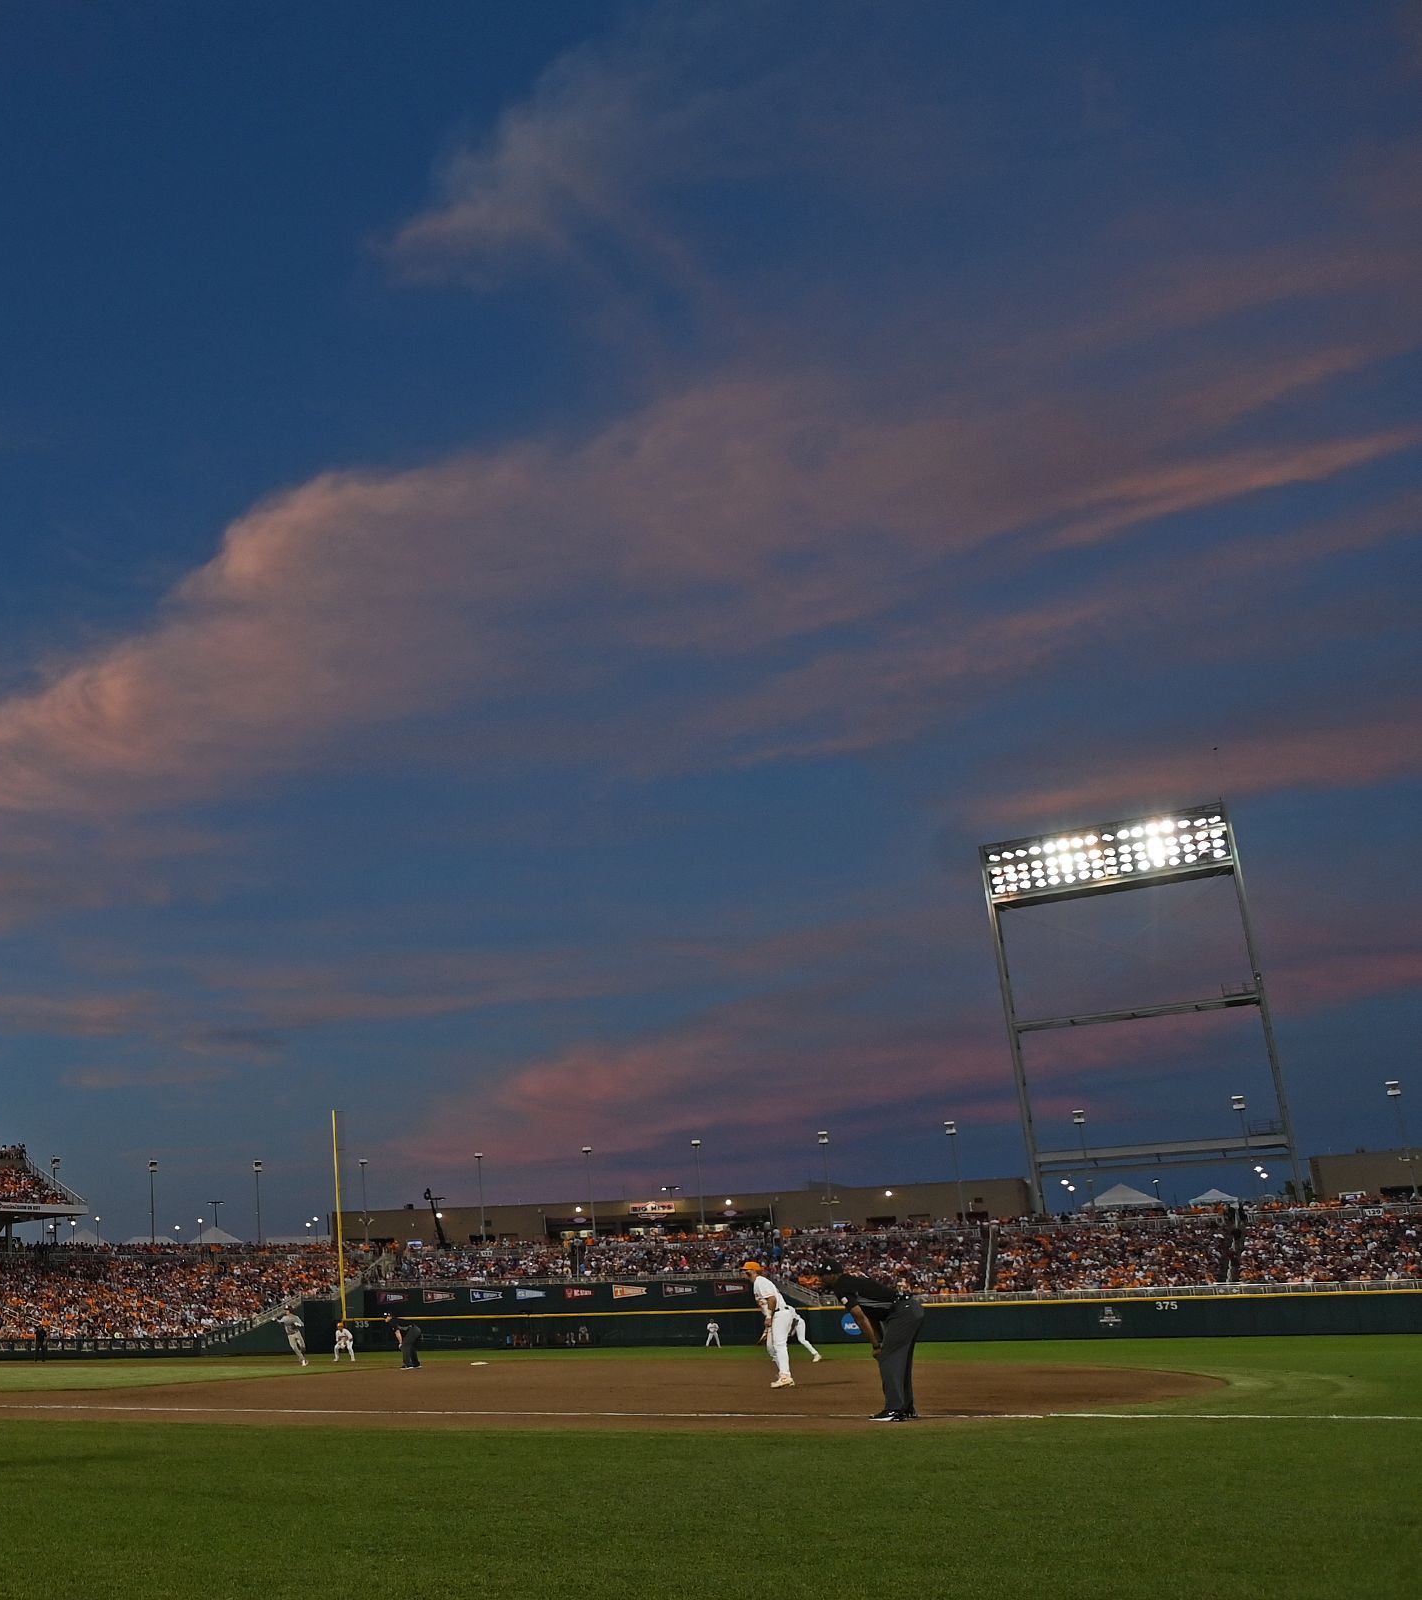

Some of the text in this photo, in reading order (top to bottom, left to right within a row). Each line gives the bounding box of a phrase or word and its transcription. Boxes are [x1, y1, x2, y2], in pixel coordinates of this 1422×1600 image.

[1155, 1301, 1178, 1310] 375
[354, 1320, 370, 1328] 335
[844, 1322, 860, 1330] NC
